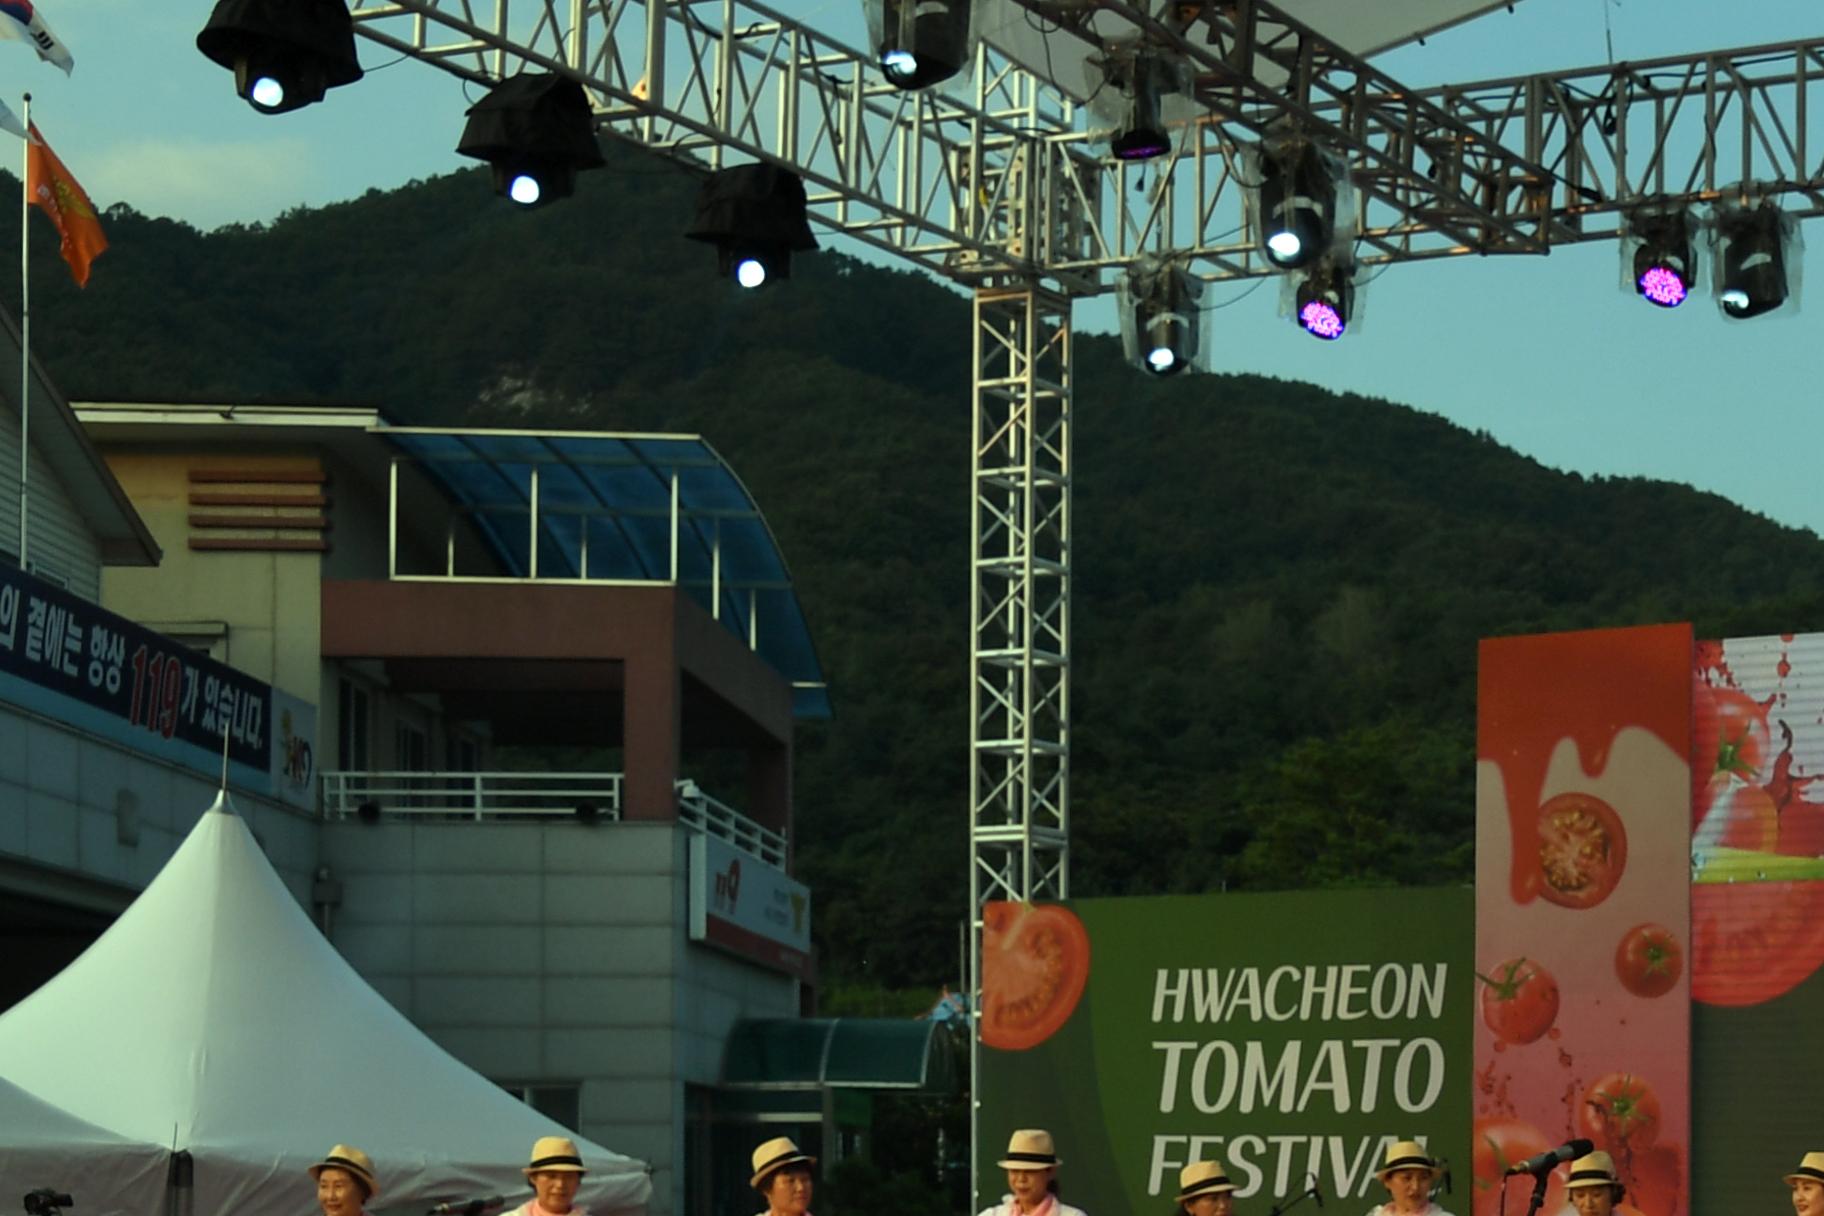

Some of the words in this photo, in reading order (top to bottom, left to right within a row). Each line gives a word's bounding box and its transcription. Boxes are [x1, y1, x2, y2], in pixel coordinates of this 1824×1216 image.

[25, 595, 83, 677] 곁에는
[88, 623, 126, 695] 항상
[129, 643, 200, 740] 119가
[1151, 962, 1448, 1024] HWACHEON
[1151, 1037, 1445, 1117] TOMATO
[1148, 1134, 1428, 1199] FSTIVA
